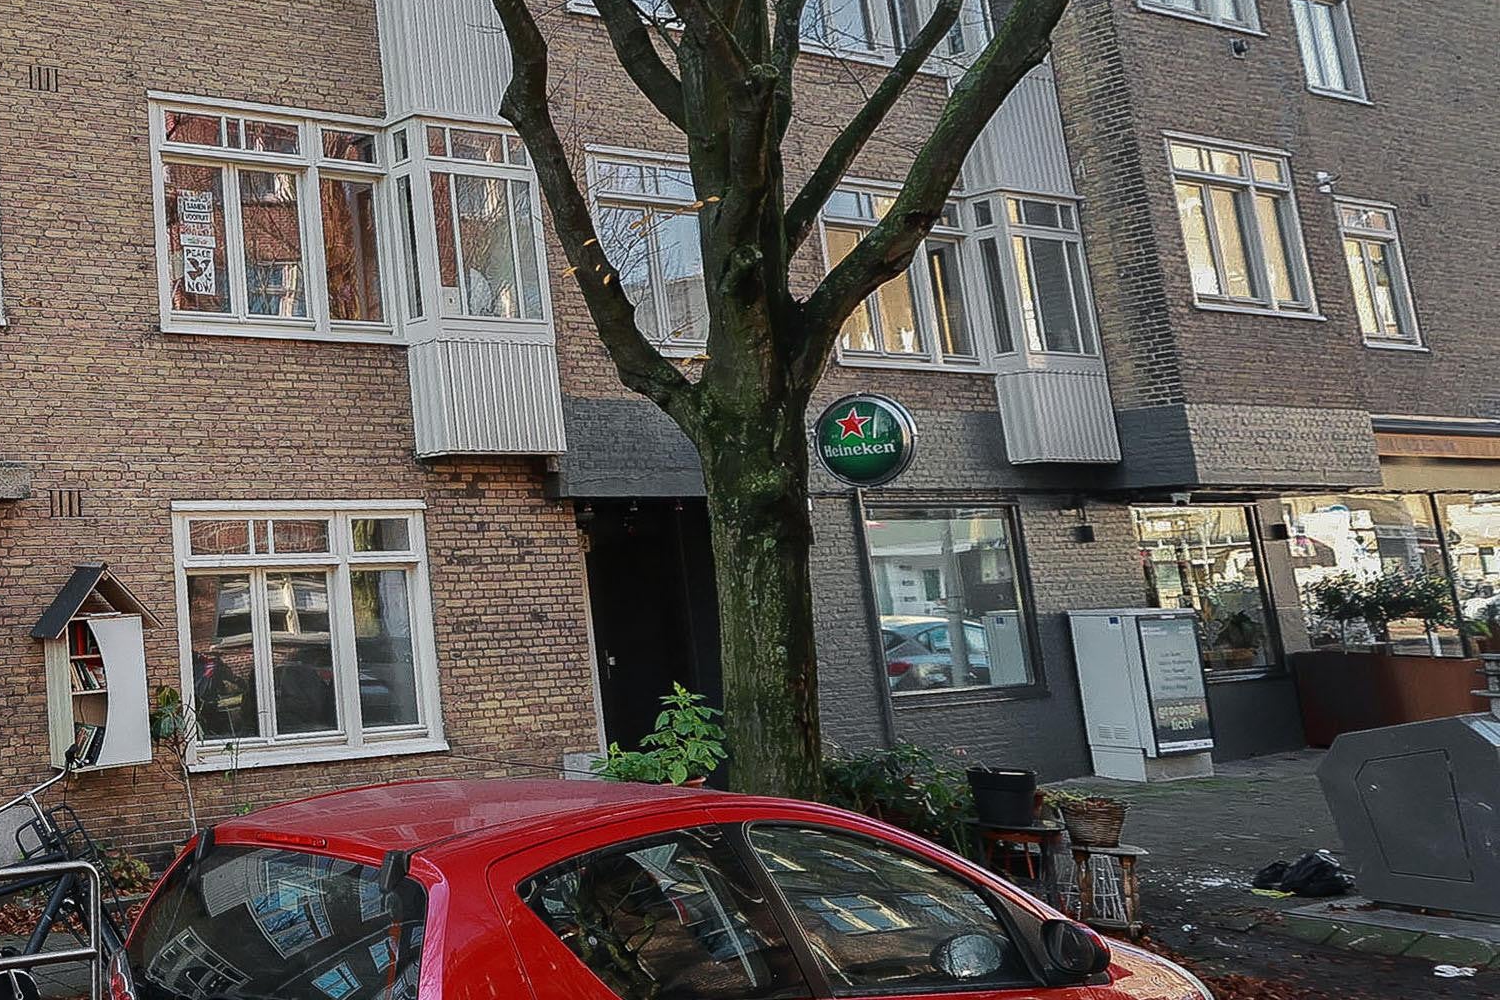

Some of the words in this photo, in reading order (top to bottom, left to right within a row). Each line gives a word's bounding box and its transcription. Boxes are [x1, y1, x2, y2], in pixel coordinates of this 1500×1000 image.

[186, 248, 212, 259] PEACE
[187, 281, 213, 294] NOW
[823, 442, 897, 458] Heineken
